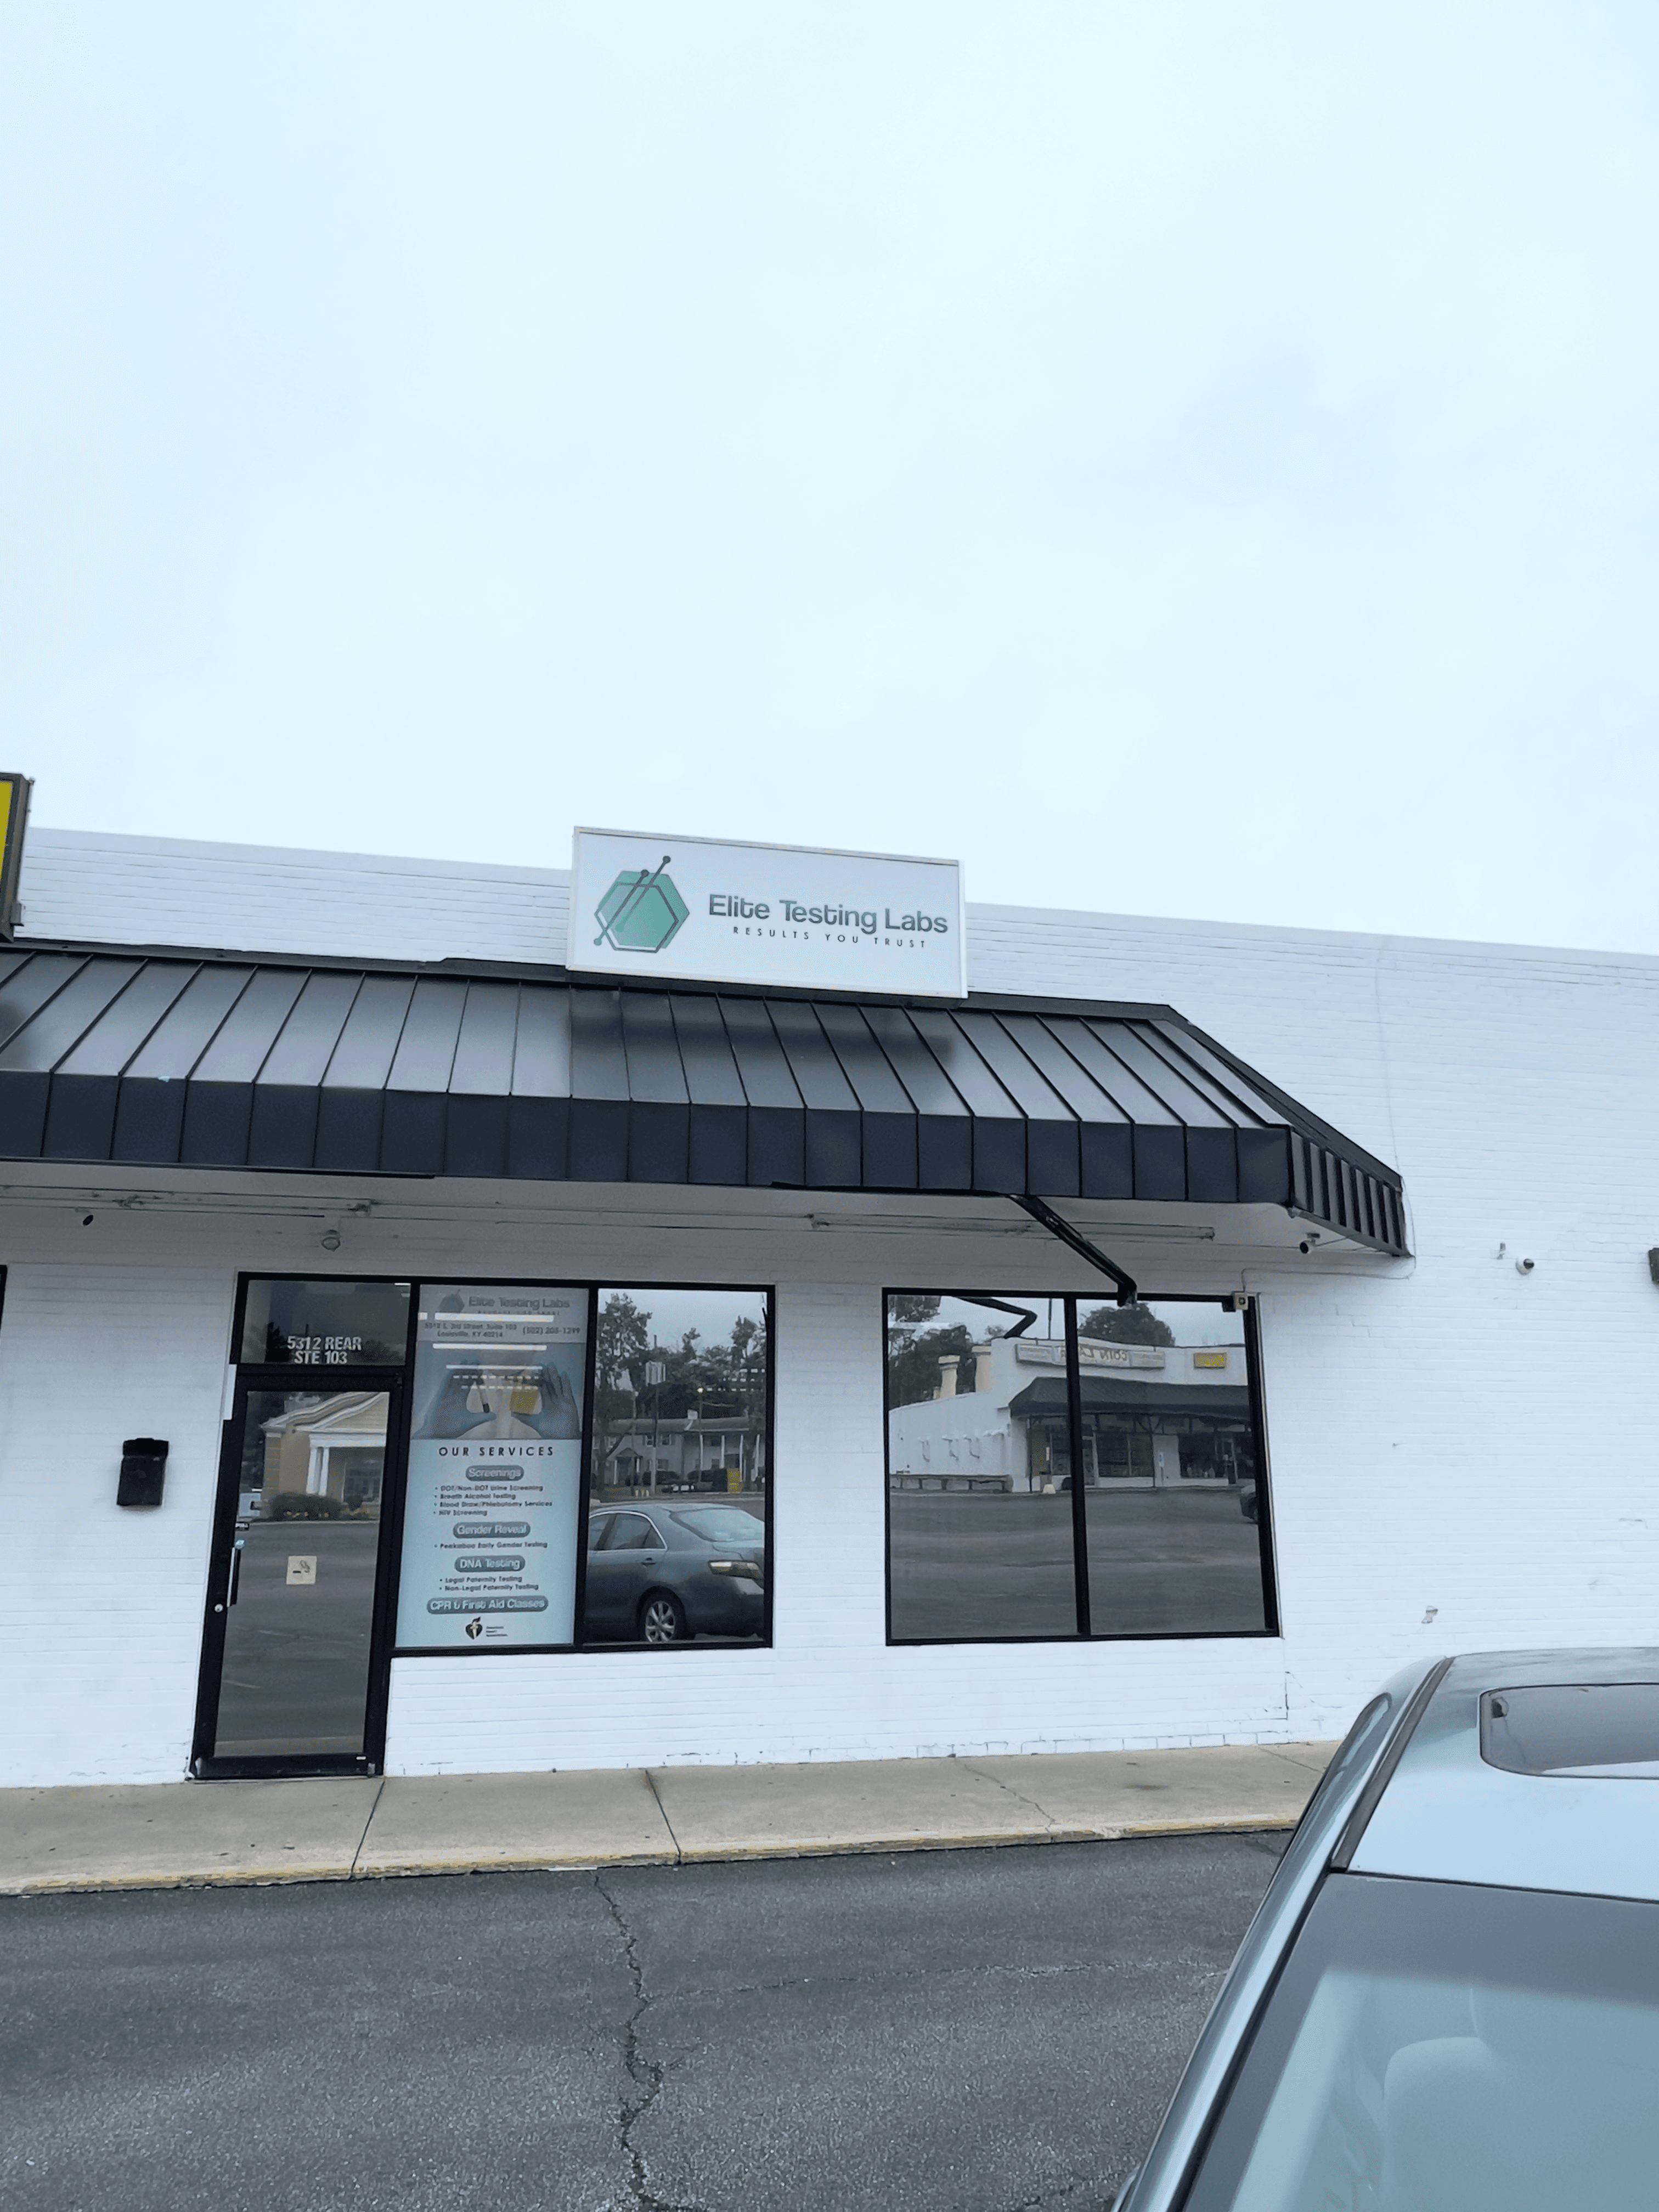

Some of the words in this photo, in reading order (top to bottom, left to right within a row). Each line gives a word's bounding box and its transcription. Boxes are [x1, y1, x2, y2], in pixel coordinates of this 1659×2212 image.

[709, 893, 770, 920] Elite
[779, 899, 877, 935] Testing
[885, 908, 949, 934] Labs
[733, 926, 810, 940] RESULTS
[825, 933, 859, 944] YOU
[874, 936, 927, 949] TRUST
[499, 1297, 540, 1311] Testing
[542, 1299, 570, 1309] Labs
[287, 1335, 321, 1350] 5312
[324, 1336, 362, 1351] REAR
[294, 1350, 319, 1364] STE
[324, 1350, 348, 1364] 103
[438, 1446, 470, 1457] OUR
[479, 1446, 554, 1457] SERVICES
[468, 1467, 522, 1479] Screenings
[457, 1525, 492, 1535] Gender
[494, 1524, 527, 1534] Reveal
[459, 1559, 482, 1569] DNA
[486, 1558, 521, 1571] Testing
[445, 1576, 465, 1584] Legal
[430, 1600, 452, 1611] CPR
[462, 1600, 487, 1610] First
[488, 1599, 505, 1610] Aid
[507, 1599, 545, 1609] Classes
